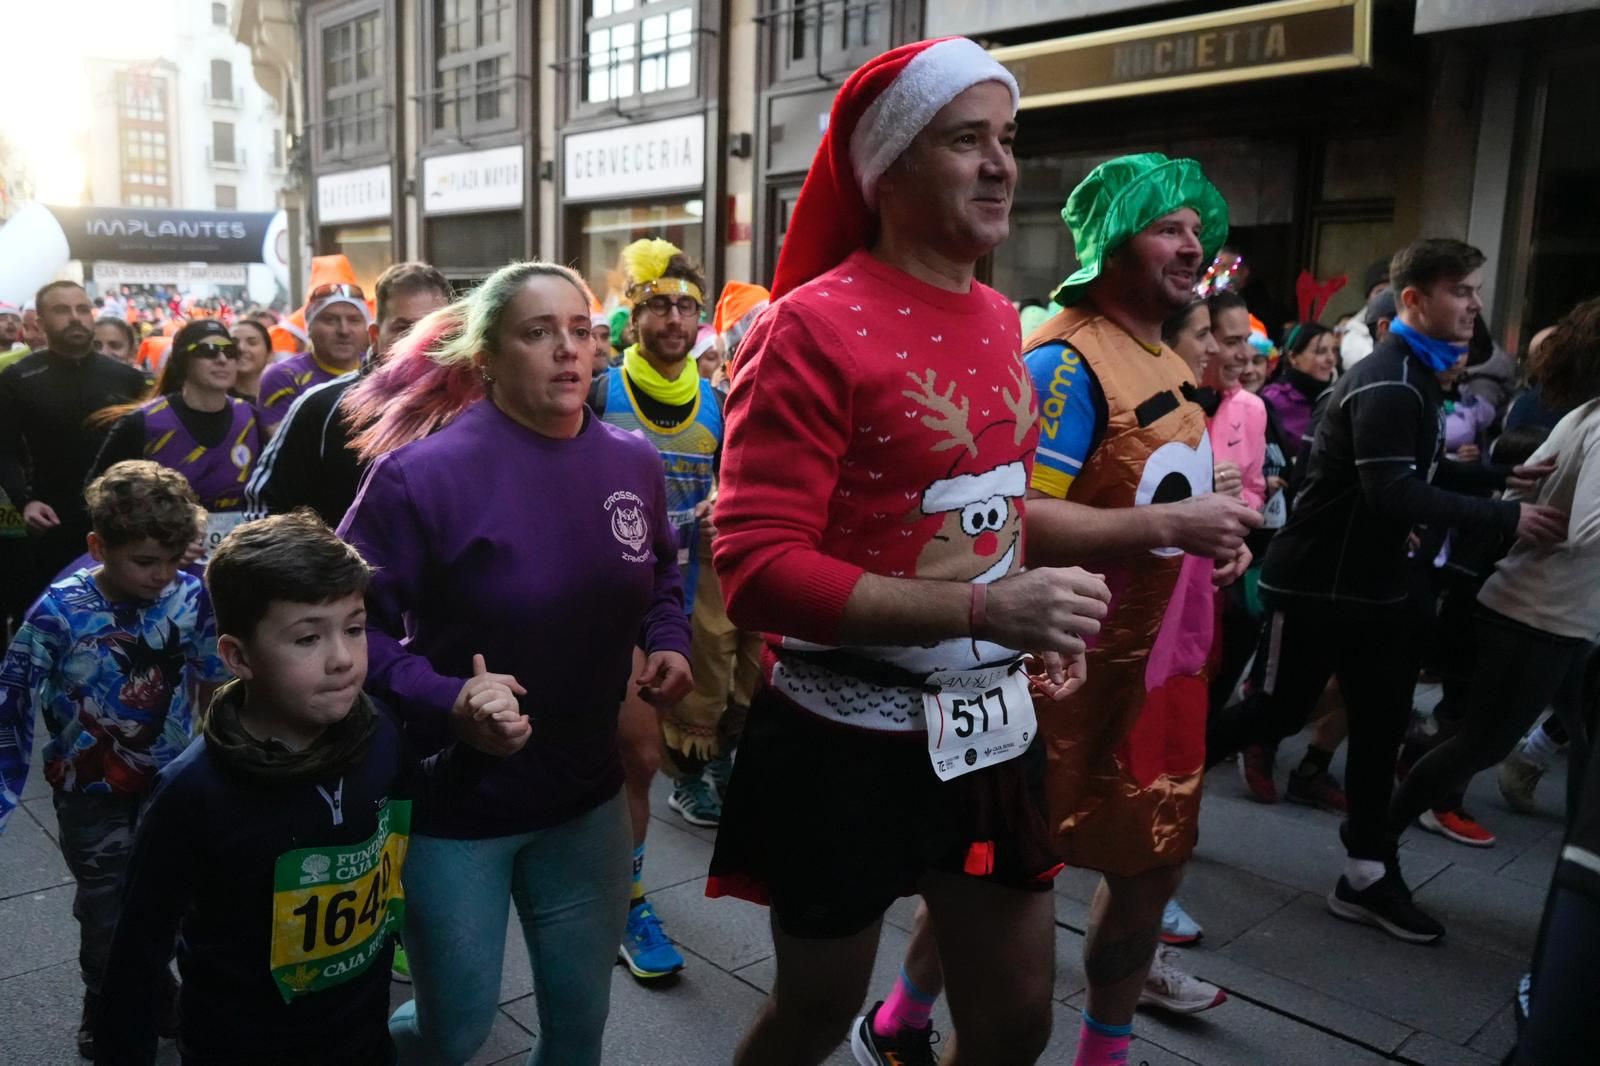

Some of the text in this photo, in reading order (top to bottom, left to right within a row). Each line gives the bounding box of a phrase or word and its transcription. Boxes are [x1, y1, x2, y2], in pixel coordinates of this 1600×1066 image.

[86, 218, 247, 239] IMPLANTES
[603, 491, 645, 511] CROSSFIT
[952, 686, 1008, 738] 577
[336, 860, 373, 880] CAJA
[323, 954, 366, 977] CAJA
